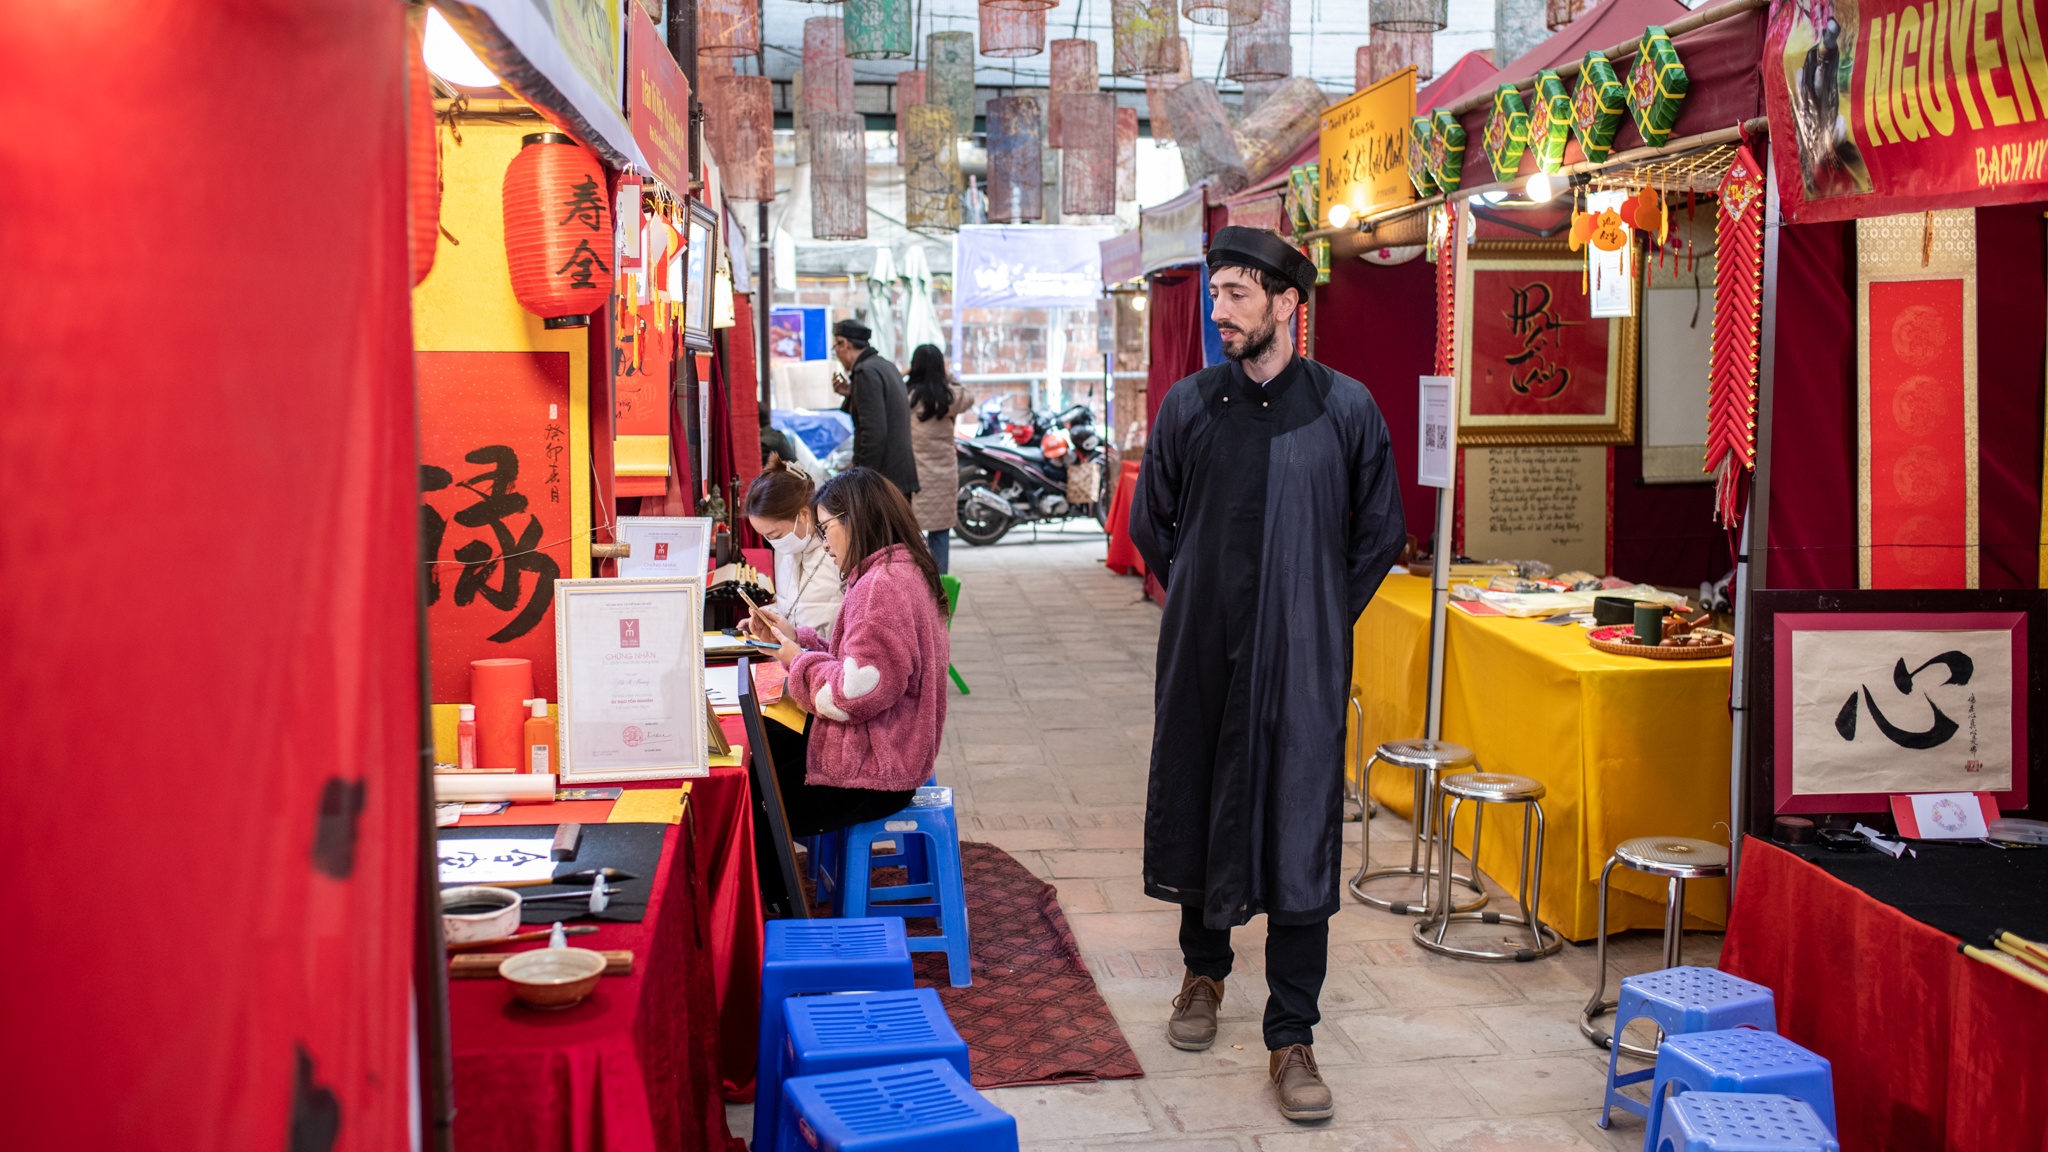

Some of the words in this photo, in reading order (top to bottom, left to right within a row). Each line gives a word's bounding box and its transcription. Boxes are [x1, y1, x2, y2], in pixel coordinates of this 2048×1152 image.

[1975, 141, 2023, 191] BẠCH
[605, 651, 633, 661] CHỨNG
[634, 650, 656, 660] NHẬN
[1834, 649, 1974, 749] 心
